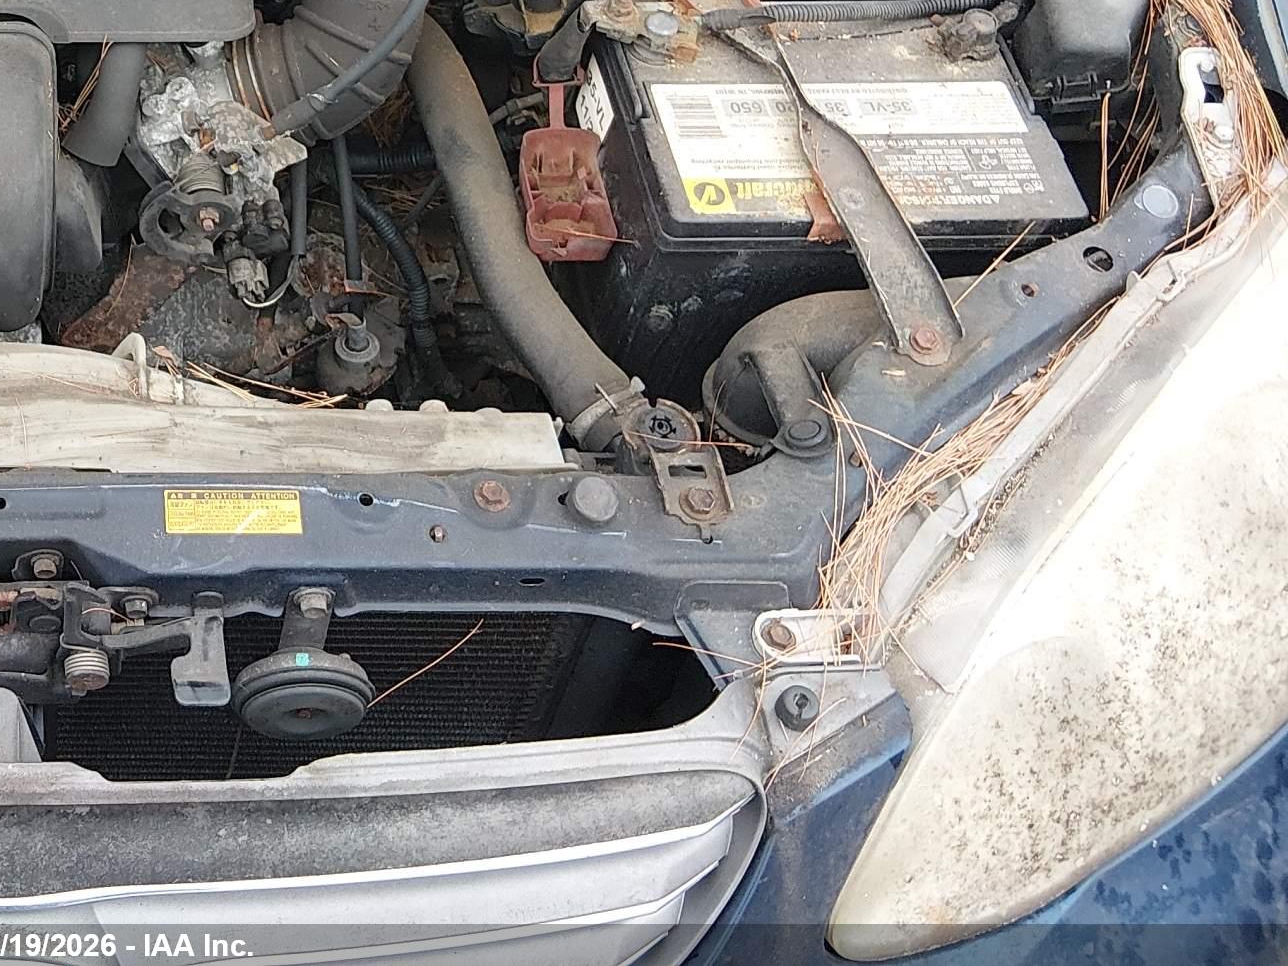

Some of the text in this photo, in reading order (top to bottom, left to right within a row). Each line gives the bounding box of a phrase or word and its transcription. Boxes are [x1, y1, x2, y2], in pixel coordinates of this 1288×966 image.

[586, 68, 605, 131] 35-VL
[730, 102, 762, 114] 650
[824, 102, 844, 113] 35
[864, 101, 912, 113] 35-VL
